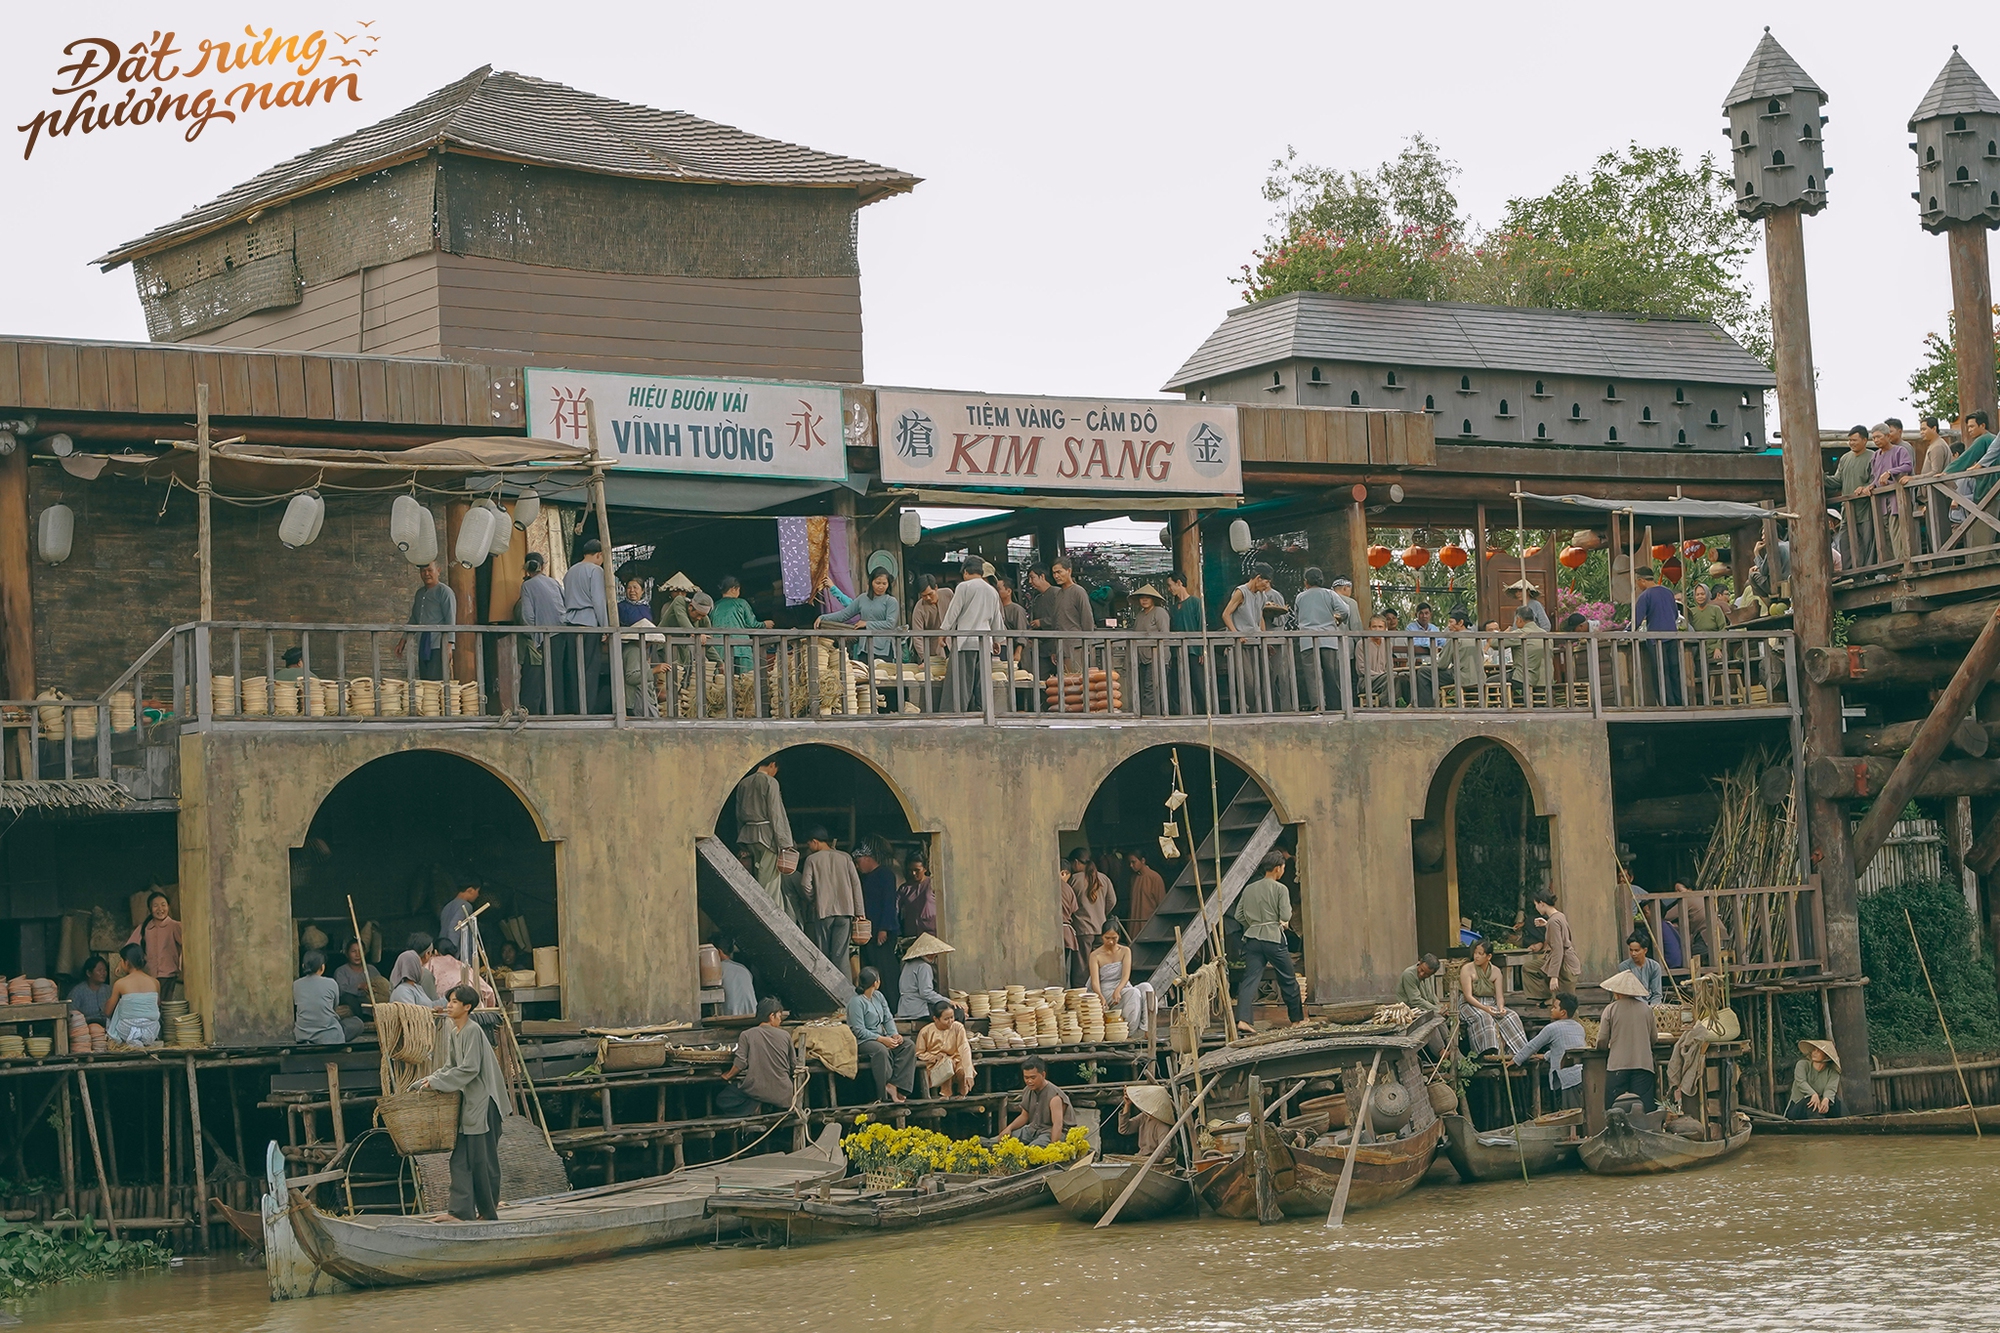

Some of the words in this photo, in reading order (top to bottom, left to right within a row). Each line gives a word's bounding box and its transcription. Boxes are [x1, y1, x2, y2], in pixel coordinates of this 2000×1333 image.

[549, 386, 588, 440] 祥
[628, 384, 668, 411] HIỆU
[671, 387, 718, 411] BUÔN
[723, 387, 748, 413] VẢI
[966, 402, 1010, 430] TIỆM
[1016, 403, 1066, 430] VÀNG
[1086, 405, 1126, 432] CẦM
[1131, 407, 1158, 433] ĐỒ
[611, 414, 682, 457] VĨNH
[688, 418, 774, 463] TƯỜNG
[785, 399, 826, 451] 永
[1191, 423, 1224, 464] 金
[945, 433, 1045, 476] KIM
[1056, 436, 1175, 482] SANG
